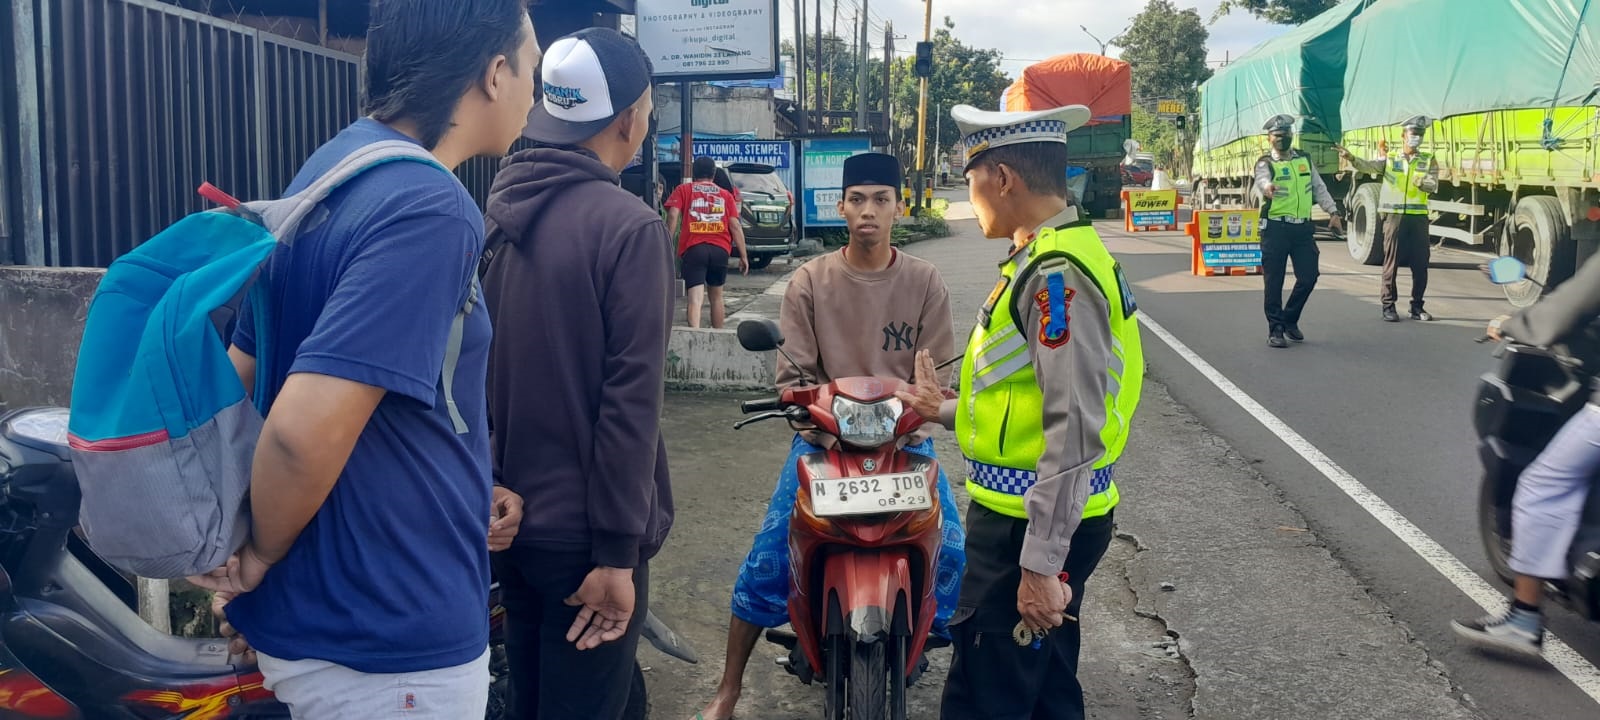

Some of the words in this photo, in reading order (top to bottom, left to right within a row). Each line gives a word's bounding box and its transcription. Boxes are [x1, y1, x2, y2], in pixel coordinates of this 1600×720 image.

[643, 13, 697, 22] PHOTOGRAPHY
[709, 8, 763, 18] VIDEOGRAPHY
[692, 144, 707, 155] LAT
[709, 144, 743, 156] NOMOR,
[745, 143, 786, 156] STEMPEL,
[815, 192, 843, 202] STEM
[1135, 200, 1169, 208] POWER
[882, 321, 914, 351] NY
[815, 482, 826, 496] N
[838, 479, 882, 496] 2632
